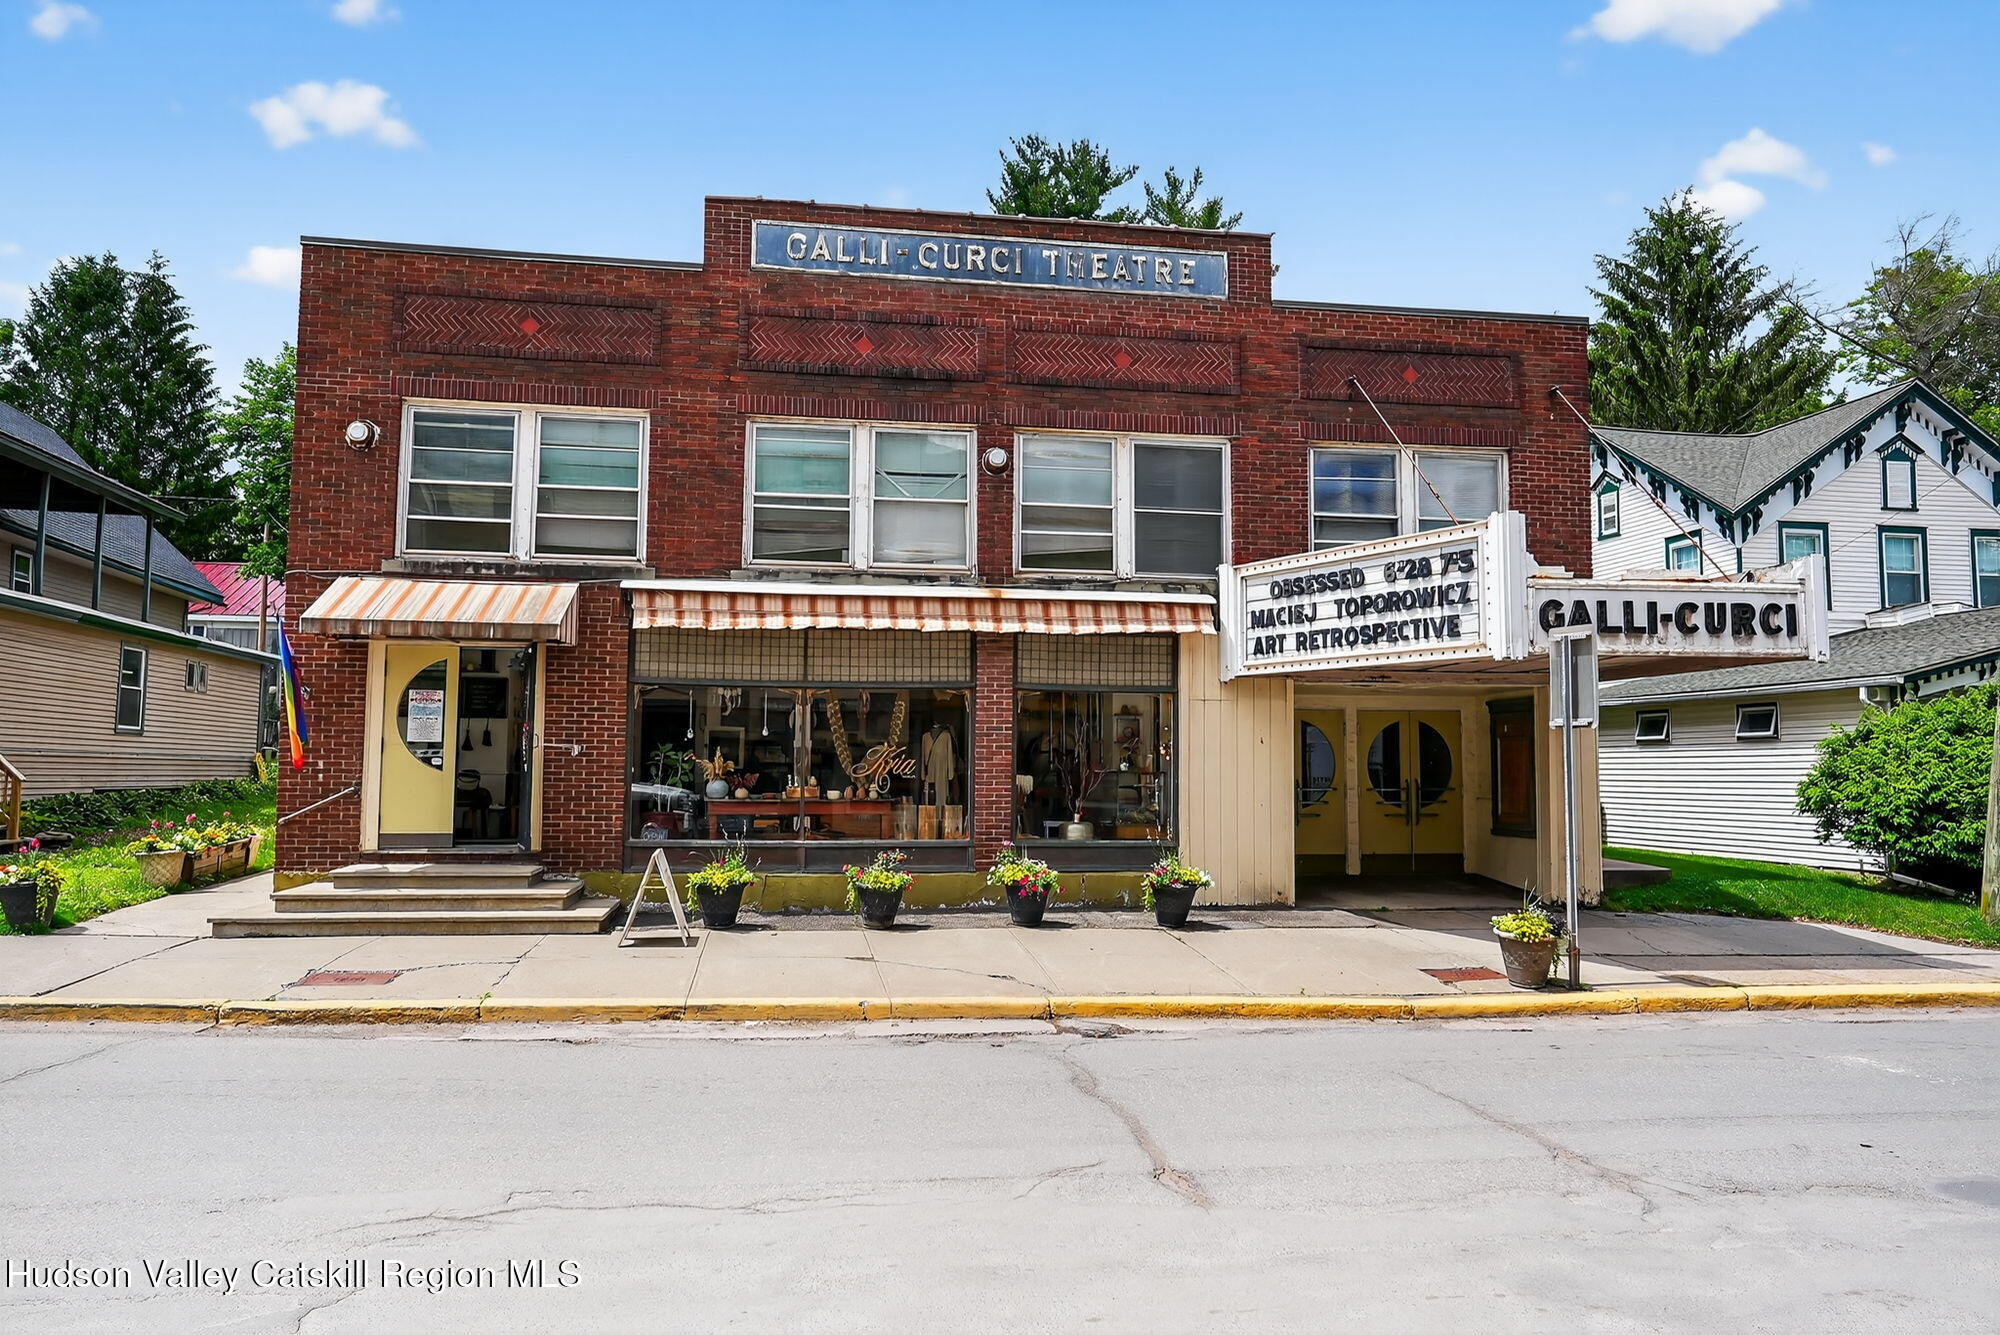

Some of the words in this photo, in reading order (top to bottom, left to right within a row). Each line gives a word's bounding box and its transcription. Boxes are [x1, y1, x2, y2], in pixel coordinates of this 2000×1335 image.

[1042, 249, 1197, 286] THEATRE
[1270, 567, 1365, 600] OBSESSED
[1250, 603, 1317, 629] MACIEJ
[1334, 580, 1472, 618] TOPOROWICZ
[1539, 599, 1798, 637] GALLI-CURCI
[1253, 635, 1287, 656] ART
[1296, 614, 1462, 652] RETROSPECTIVE
